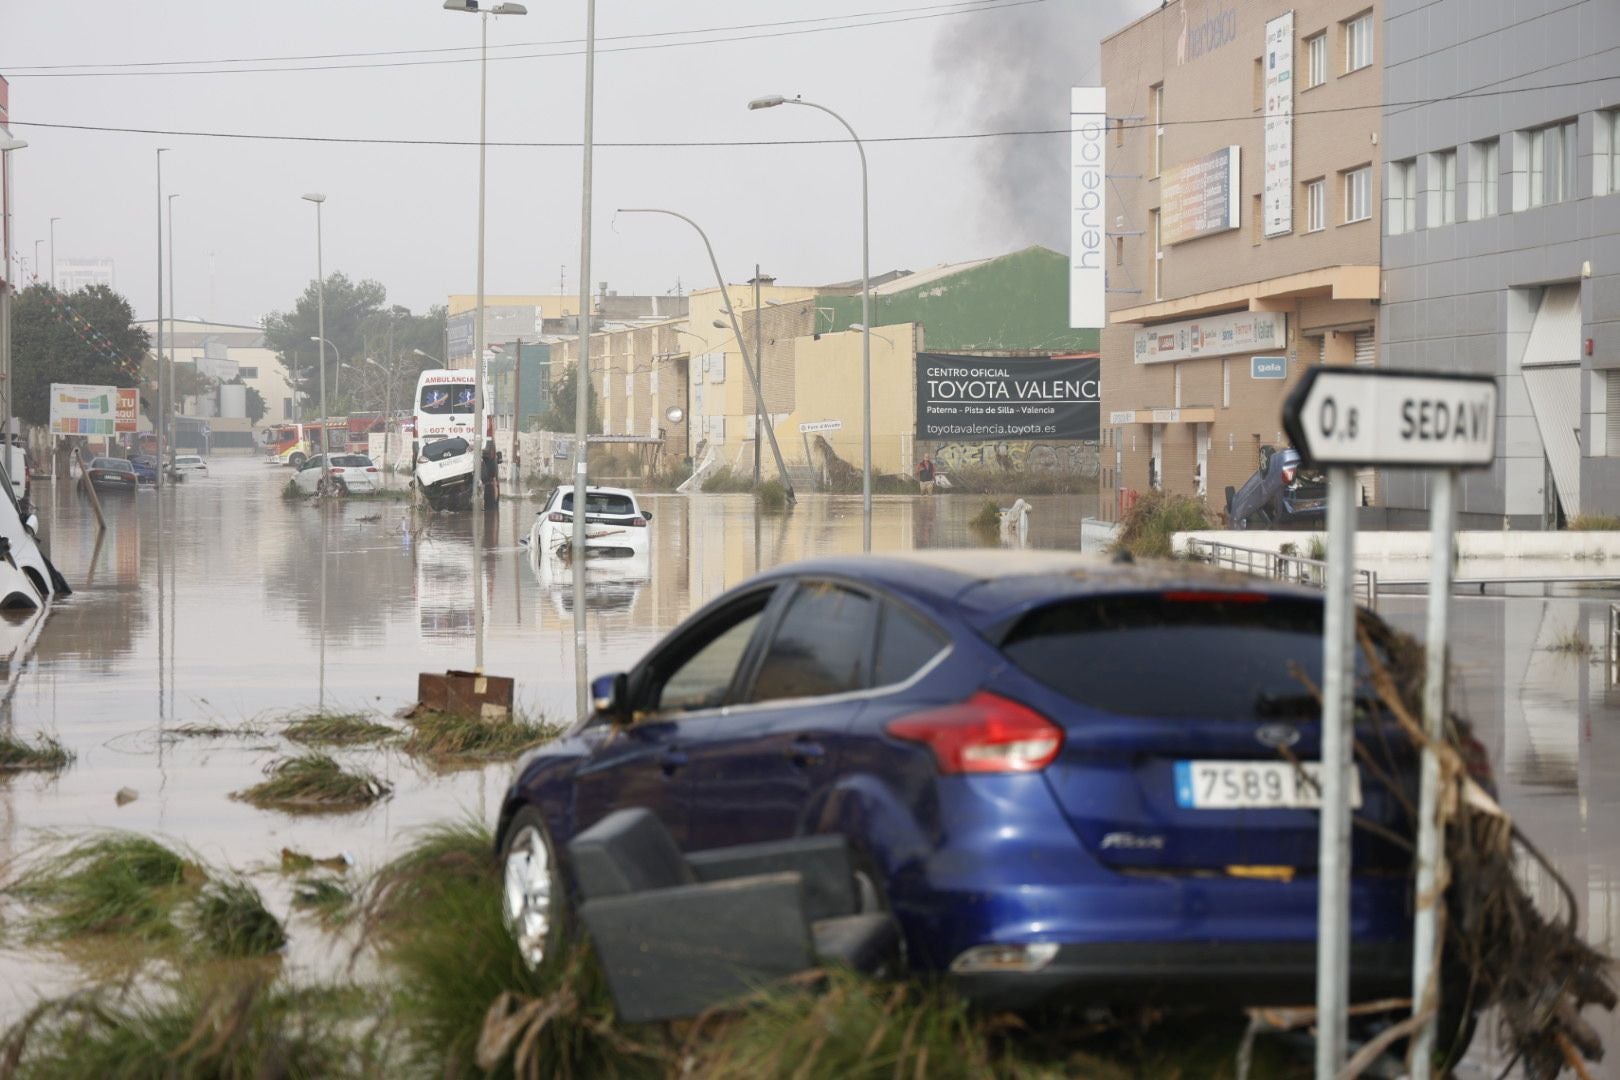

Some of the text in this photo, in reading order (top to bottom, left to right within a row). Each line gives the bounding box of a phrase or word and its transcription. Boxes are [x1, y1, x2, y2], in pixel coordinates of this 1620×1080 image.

[1073, 120, 1101, 270] herbelco
[927, 368, 1010, 378] CENTRO OFICIAL
[1257, 363, 1281, 373] gala
[927, 380, 1010, 399] TOYOTA
[121, 397, 134, 407] TU
[927, 406, 957, 414] Paterna
[964, 406, 983, 414] Pista
[985, 406, 995, 414] de
[997, 406, 1014, 414] Silla
[927, 423, 1056, 436] toyotavalencia.toyota.es
[1200, 768, 1283, 800] 7589
